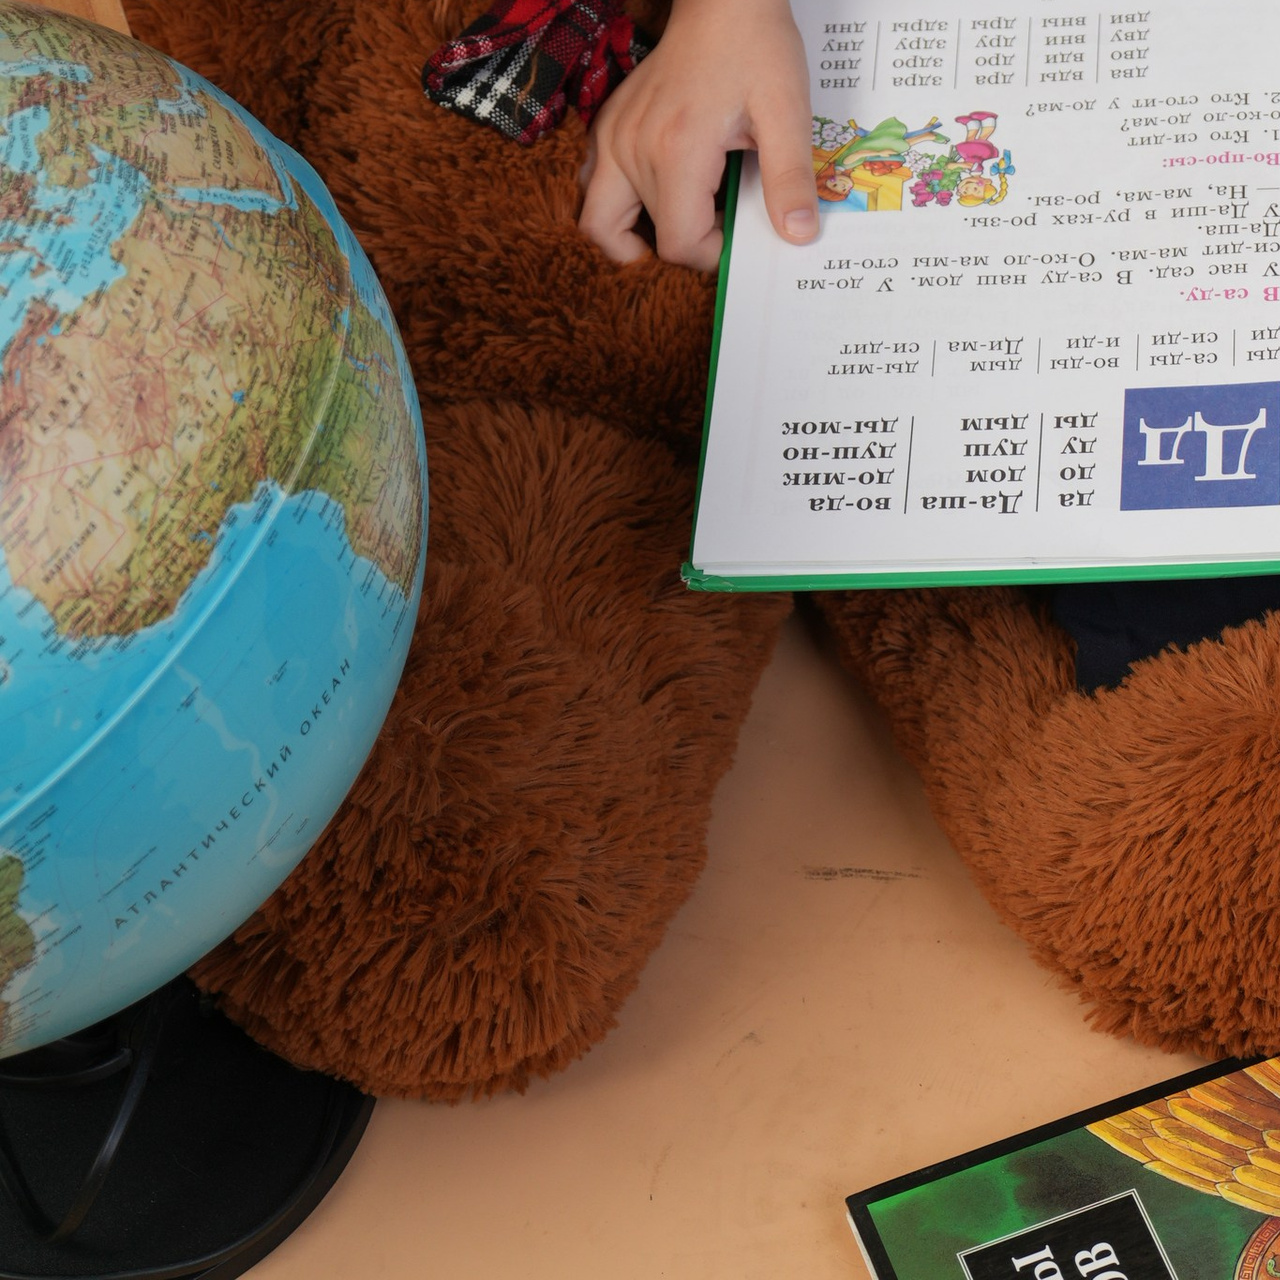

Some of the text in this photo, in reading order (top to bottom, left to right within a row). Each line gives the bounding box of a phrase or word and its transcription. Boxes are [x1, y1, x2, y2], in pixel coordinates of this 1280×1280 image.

[825, 11, 1150, 33] дви вны дры здры дни
[822, 29, 1149, 52] дву вни дру здру дну
[820, 47, 1149, 70] дво вди дро здро дно
[820, 66, 1148, 88] два вды дра здра дна
[1026, 92, 1280, 116] 2. Кто сто-ит у до-ма?
[1120, 111, 1280, 132] о-ко-ло до-ма?
[1127, 129, 1279, 146] 1. Кто си-дит
[1163, 151, 1280, 167] Во-про-сы:
[1027, 191, 1100, 206] ро-зы.
[1116, 188, 1192, 202] ма-ма,
[1208, 184, 1247, 200] На,
[964, 201, 1280, 227] У Да-ши в ру-ках ро-зы.
[1198, 219, 1280, 237] Да-ша.
[824, 241, 1280, 270] си-дит ма-ма. О-ко-ло ма-мы сто-ит
[797, 262, 1280, 292] У нас сад. В са-ду наш дом. У до-ма
[1180, 287, 1279, 301] В са-ду.
[840, 326, 1280, 355] ди си-ди и-ди Ди-ма си-дит
[828, 346, 1280, 375] ды са-ды во-ды дым ды-мит
[782, 412, 1098, 435] ды дым ды-мок
[783, 436, 1097, 461] ду душ душ-но
[1137, 407, 1267, 482] Дд
[783, 463, 1096, 486] до дом до-мик
[808, 489, 1095, 514] да Да-ша во-да
[114, 744, 293, 930] АТЛАНТИЧЕСКИЙ
[299, 657, 351, 737] ОКЕАН
